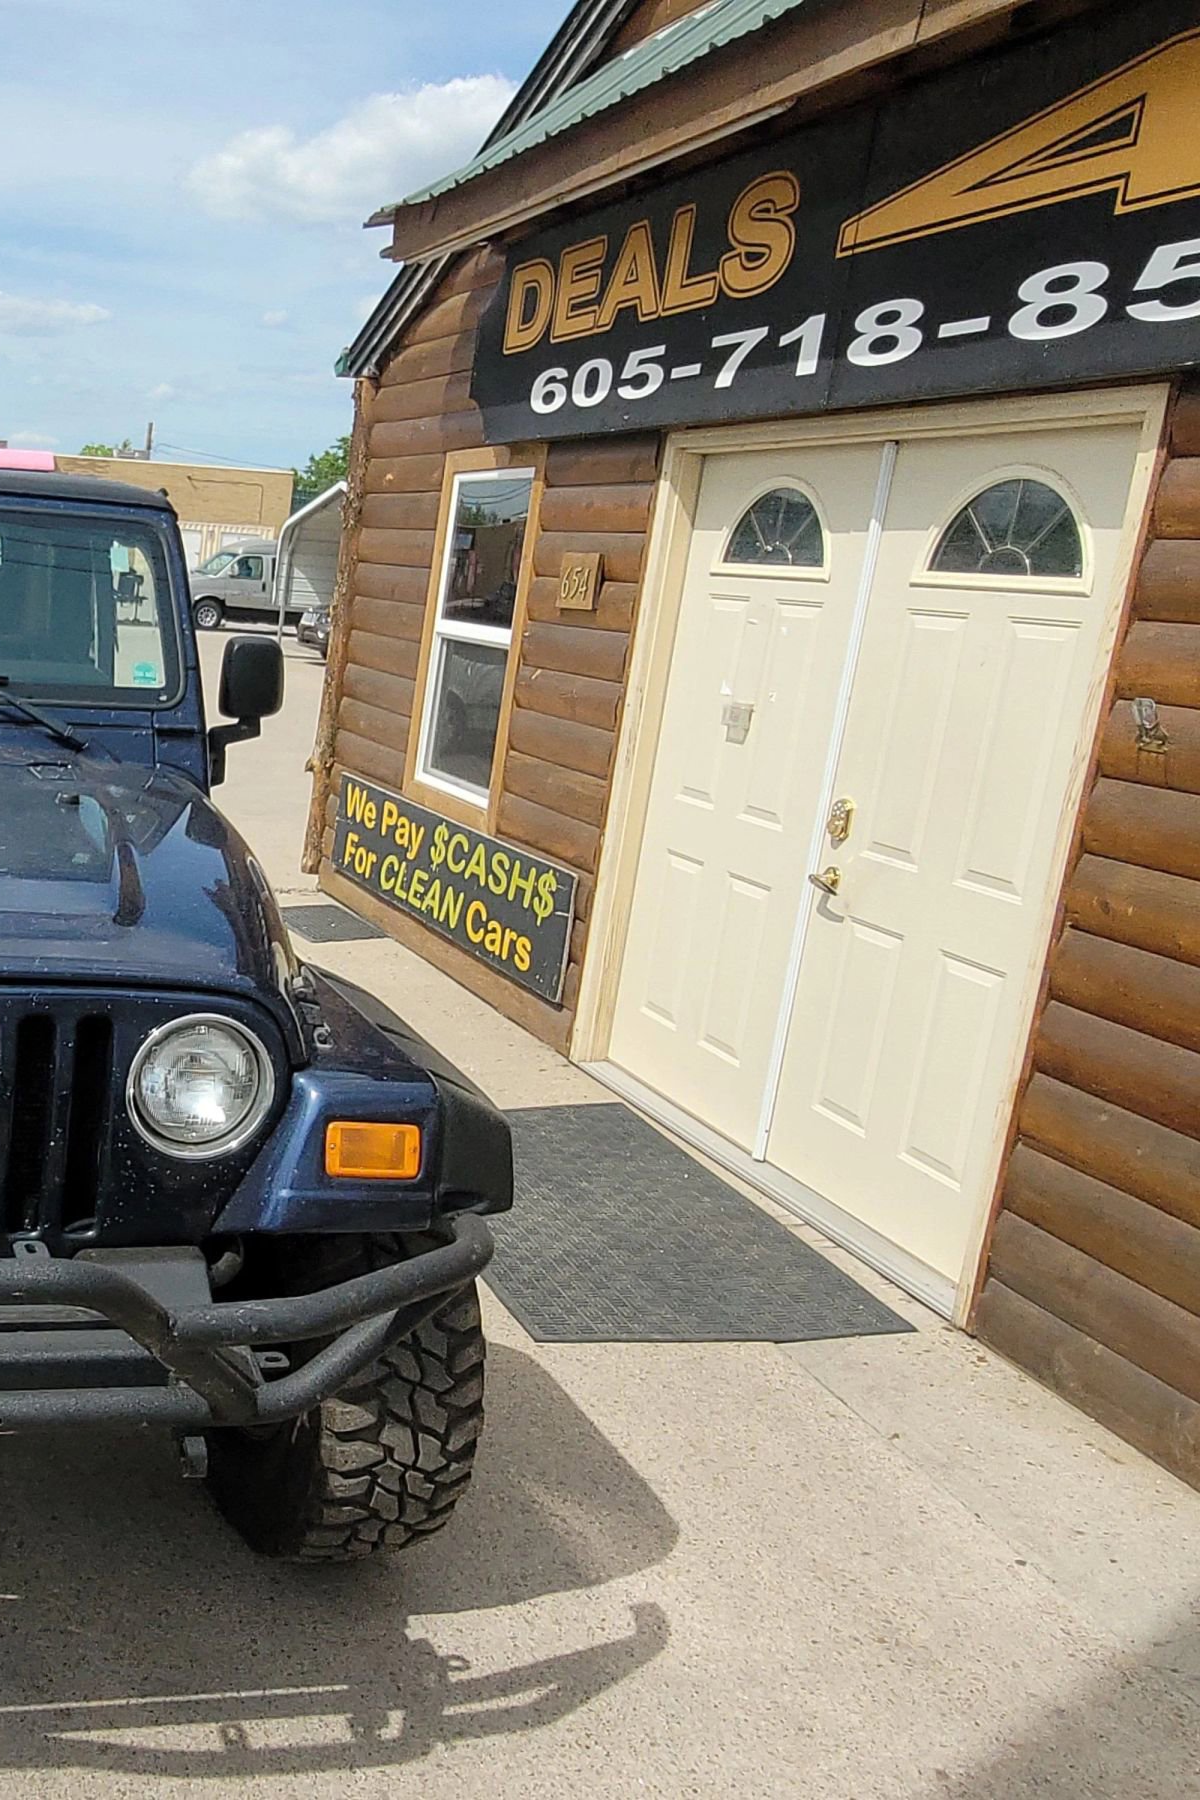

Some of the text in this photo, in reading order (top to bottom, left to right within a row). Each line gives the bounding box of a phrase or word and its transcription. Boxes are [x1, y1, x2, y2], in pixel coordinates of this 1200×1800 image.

[503, 169, 800, 354] DEALS
[529, 238, 1200, 414] 605-718-85
[560, 566, 591, 601] 654
[343, 831, 532, 973] For CLEAN Cars
[345, 782, 558, 927] We Pay $CASH$
